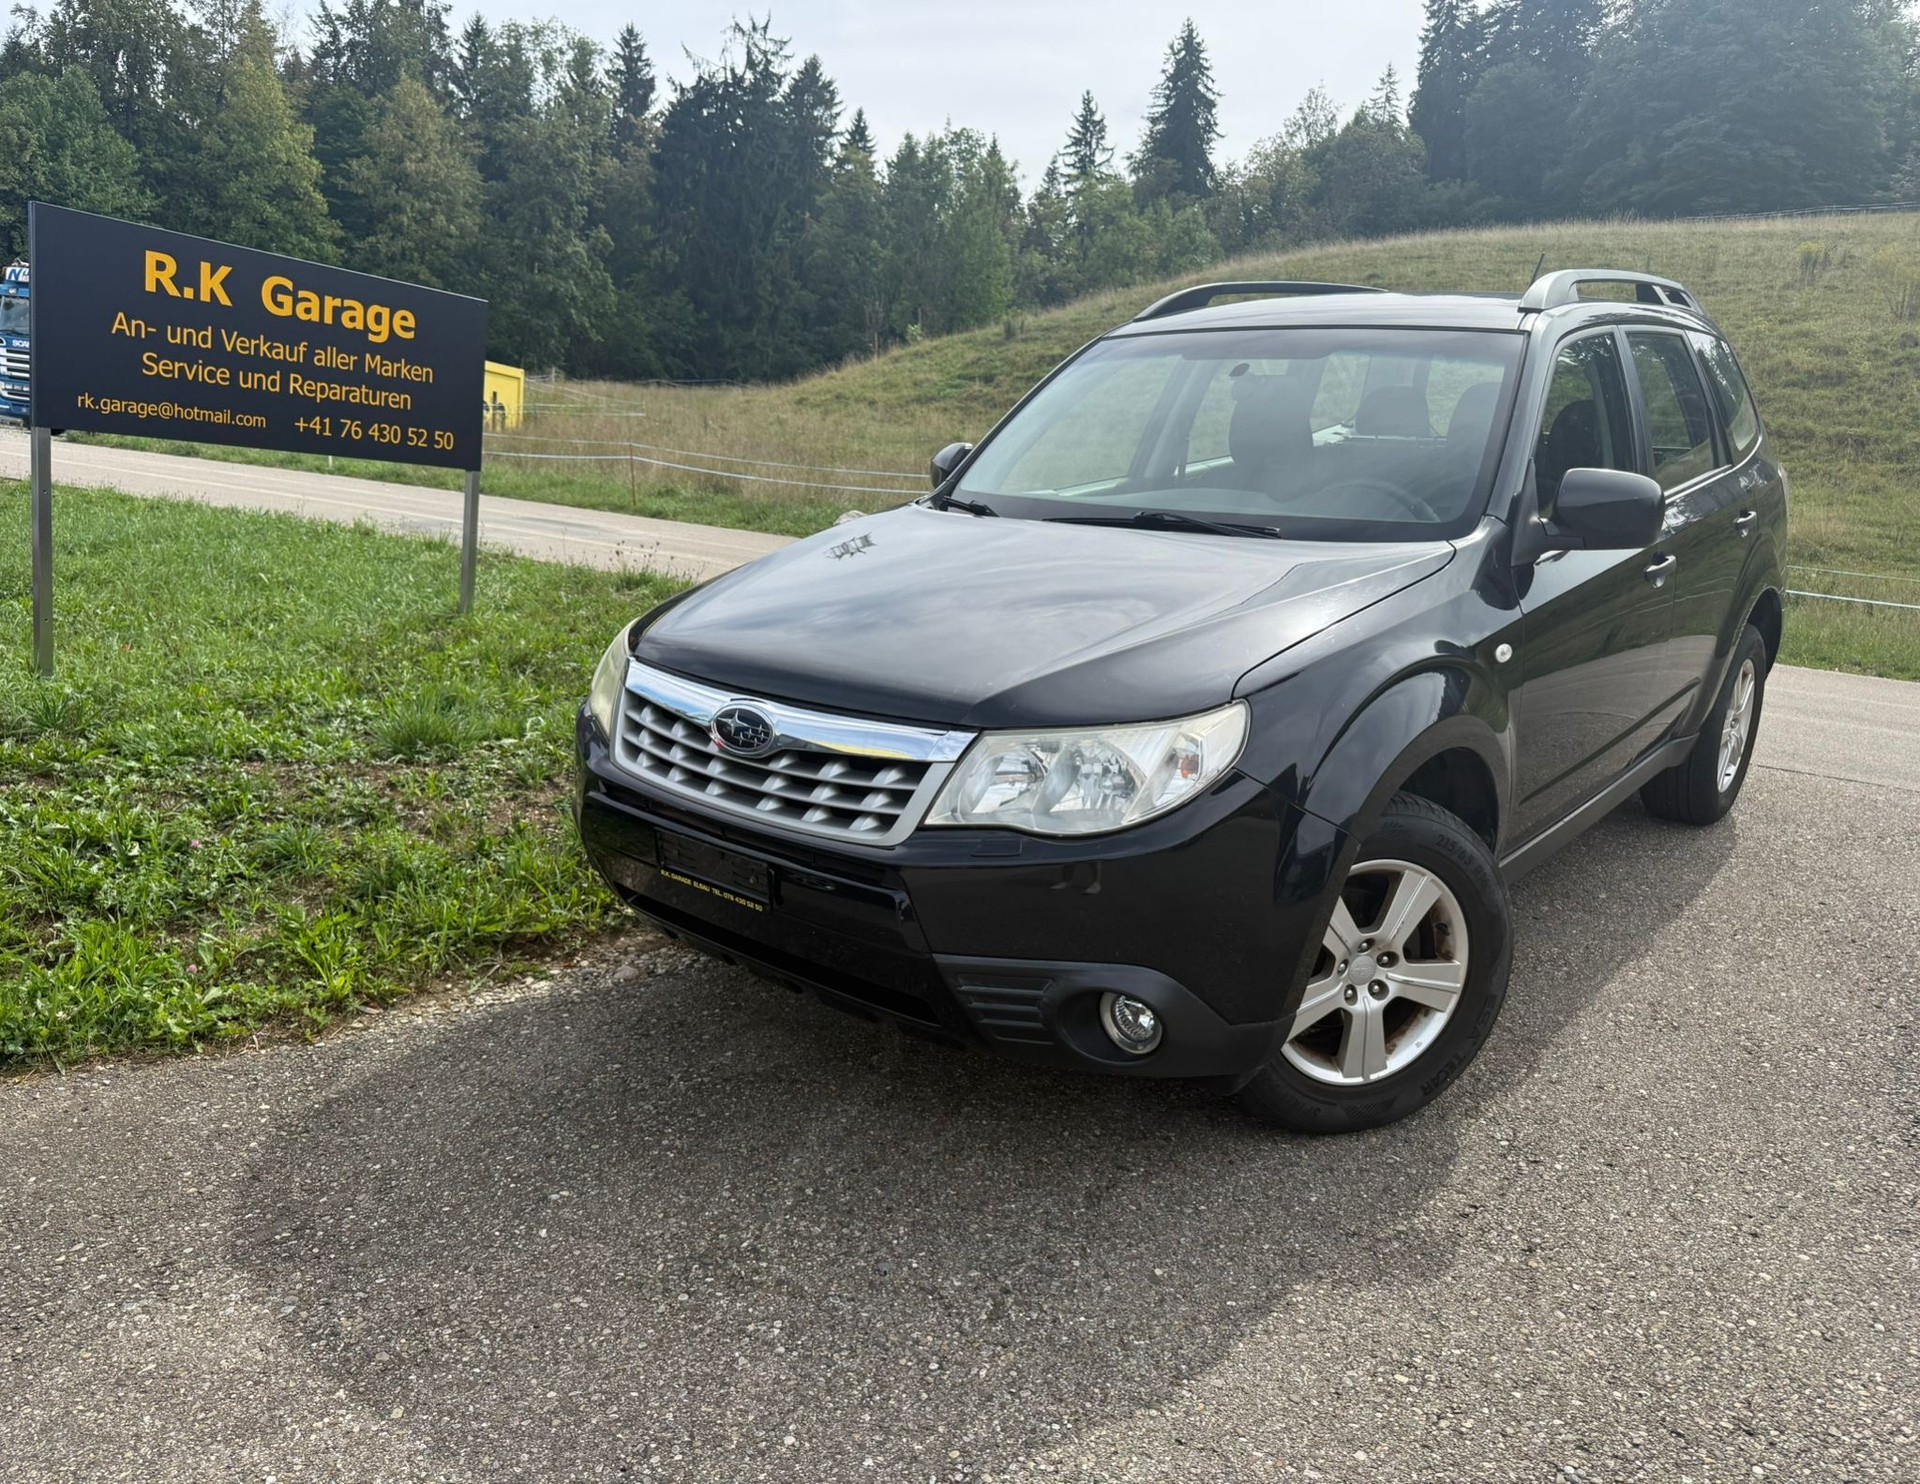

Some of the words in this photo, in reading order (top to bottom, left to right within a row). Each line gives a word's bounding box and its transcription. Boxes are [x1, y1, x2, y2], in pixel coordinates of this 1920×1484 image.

[144, 249, 234, 307] R.K
[260, 275, 416, 344] Garage
[111, 311, 156, 339] An-
[166, 327, 212, 350] und
[221, 329, 308, 364] Verkauf
[313, 346, 358, 371] aller
[364, 353, 434, 383] Marken
[77, 393, 267, 428] rk.garage@hotmail.com
[142, 352, 231, 386] Service
[239, 370, 281, 393] und
[289, 374, 412, 411] Reparaturen
[294, 416, 332, 437] +41
[340, 419, 363, 440] 76
[368, 423, 402, 445] 430
[407, 427, 428, 448] 52
[434, 430, 455, 450] 50
